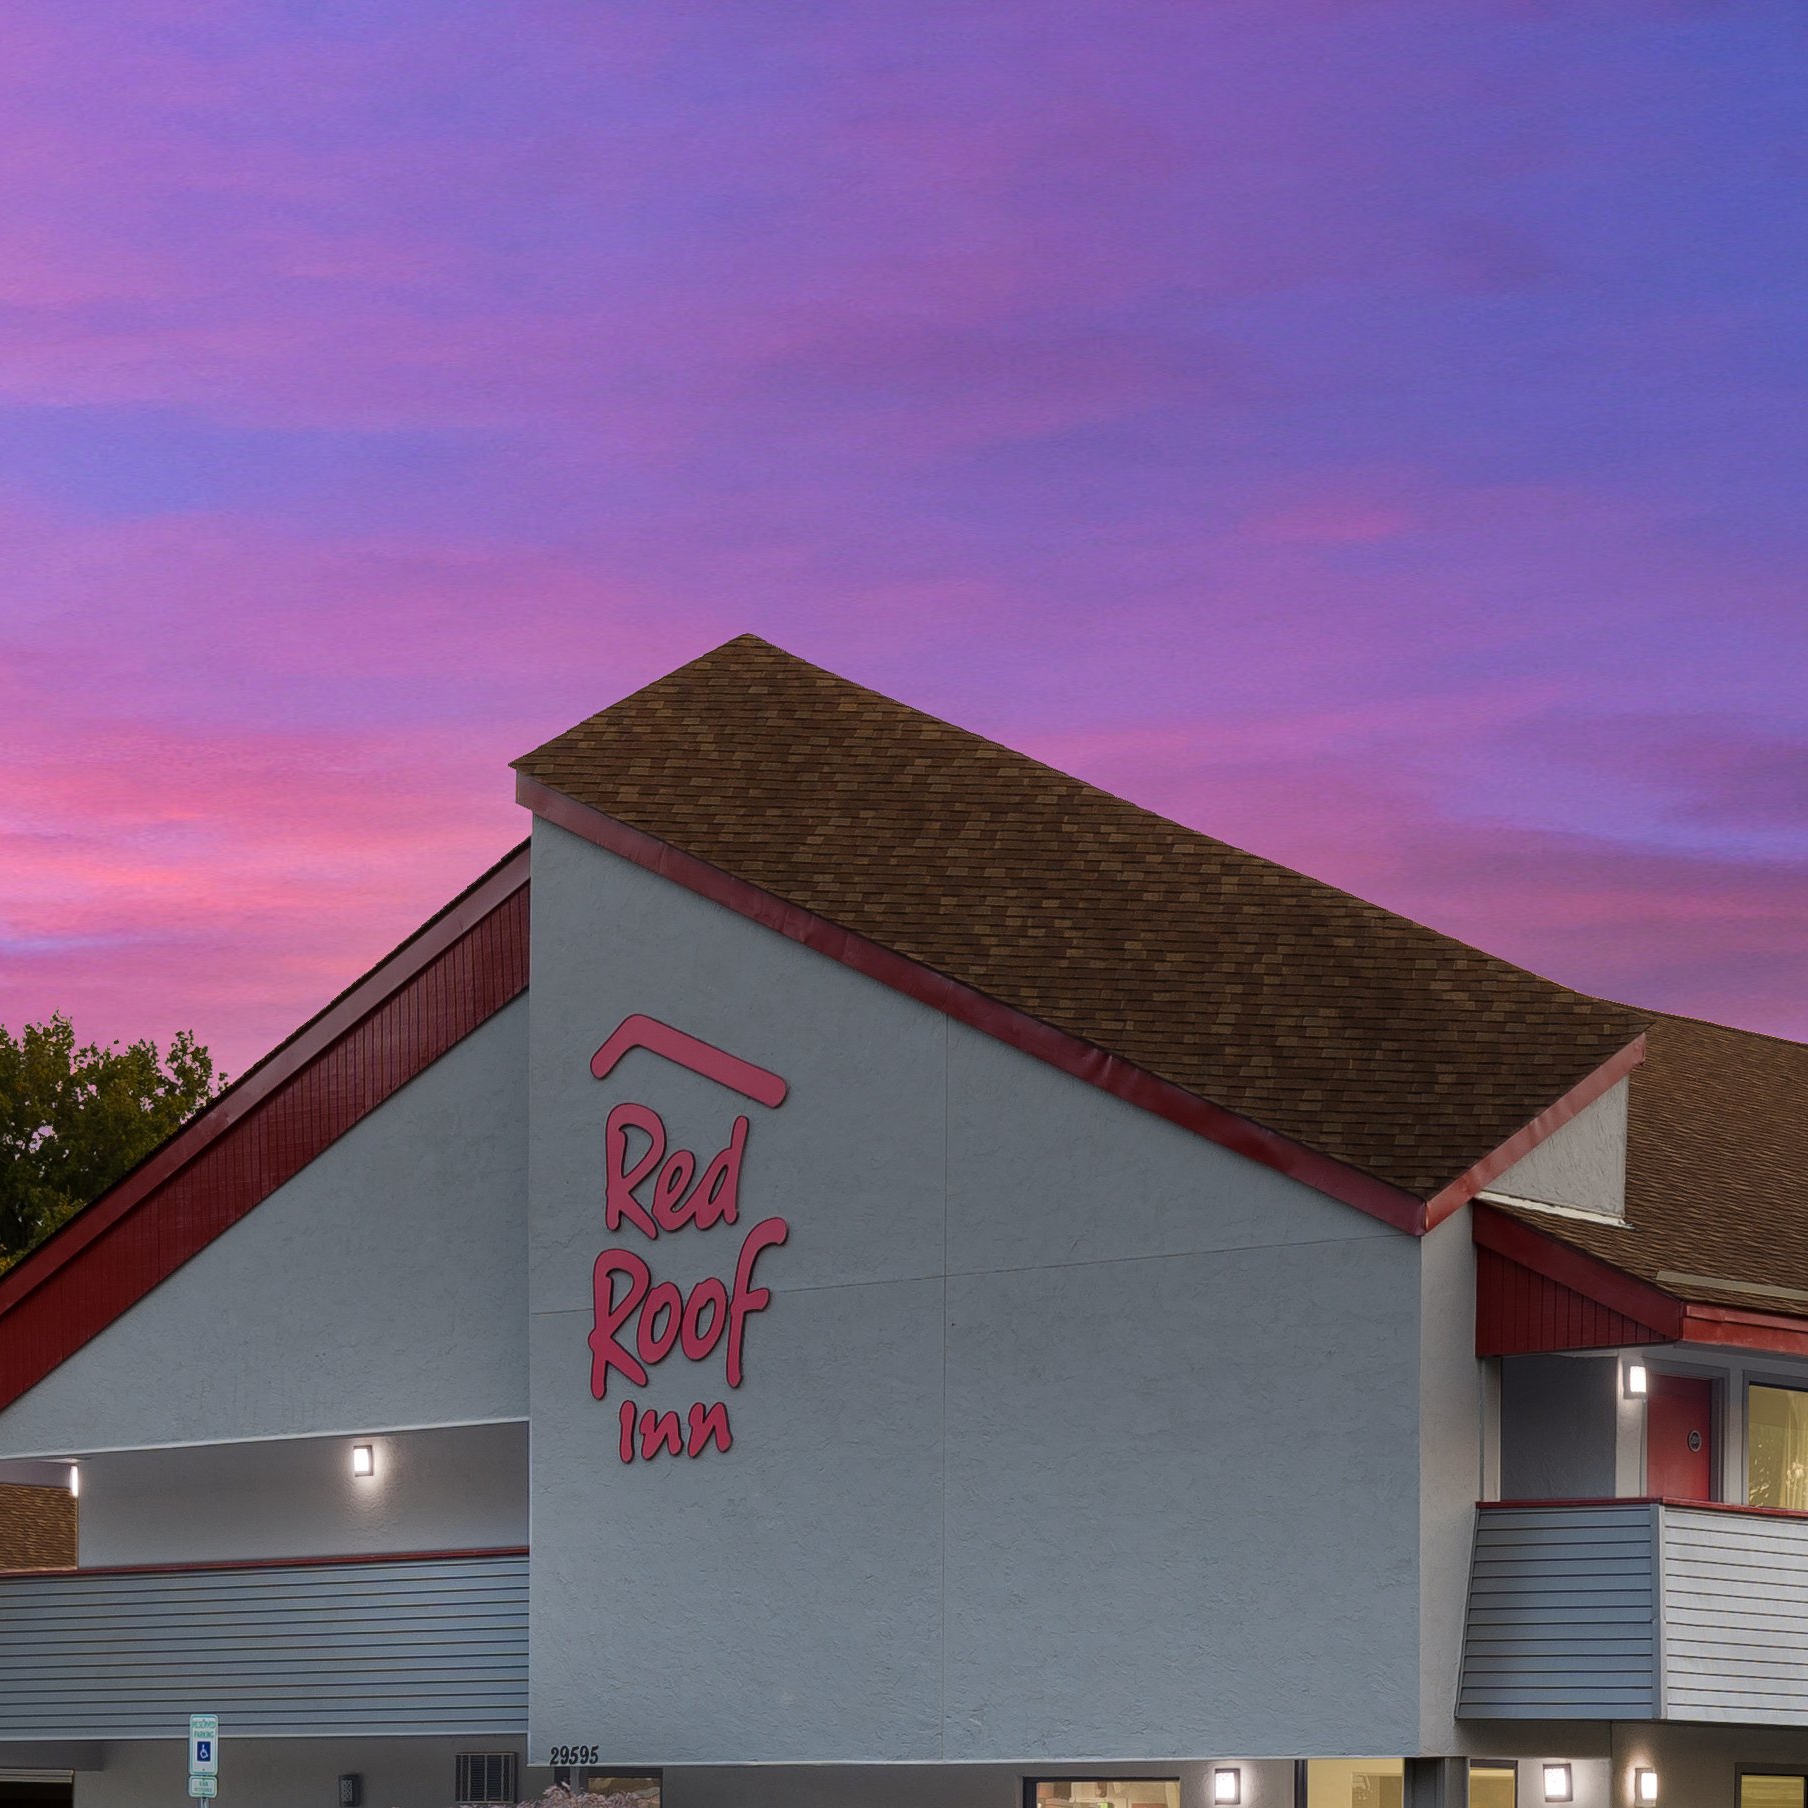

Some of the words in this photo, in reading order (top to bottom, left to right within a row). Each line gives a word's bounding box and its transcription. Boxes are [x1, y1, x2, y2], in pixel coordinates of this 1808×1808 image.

[605, 1102, 750, 1240] Red
[588, 1217, 790, 1401] Roof
[194, 1730, 214, 1738] PARKING
[550, 1745, 599, 1765] 29595
